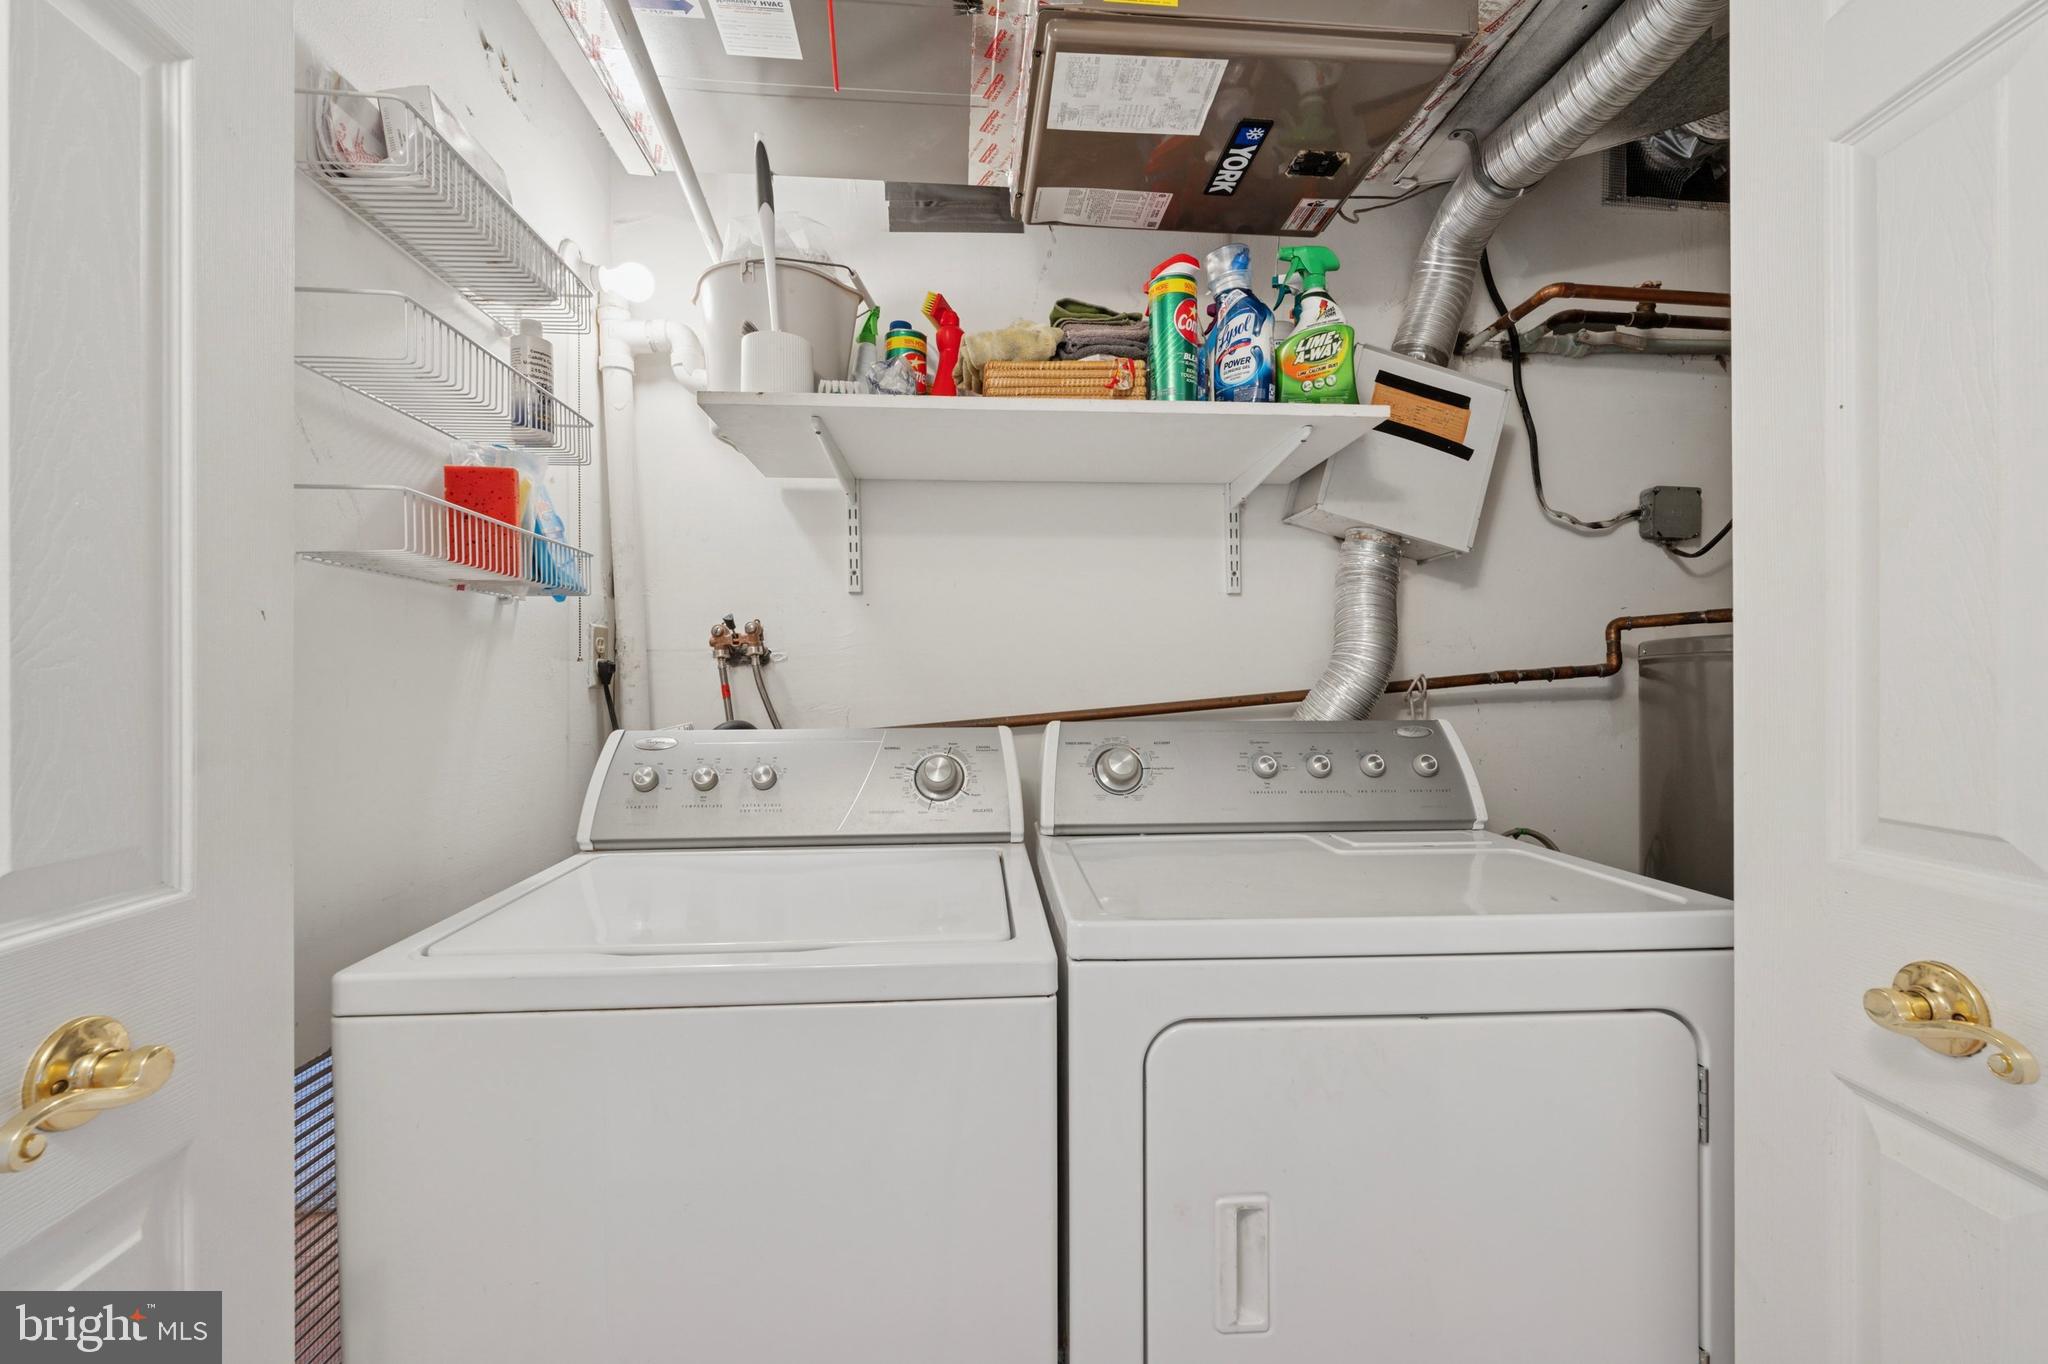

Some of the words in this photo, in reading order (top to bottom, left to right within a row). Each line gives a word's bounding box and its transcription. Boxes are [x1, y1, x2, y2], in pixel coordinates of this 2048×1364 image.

[760, 0, 784, 8] HVAC
[1208, 144, 1258, 194] YORK
[1218, 314, 1252, 352] Lysol
[1224, 356, 1251, 370] POWER
[1294, 340, 1342, 365] A-WAY
